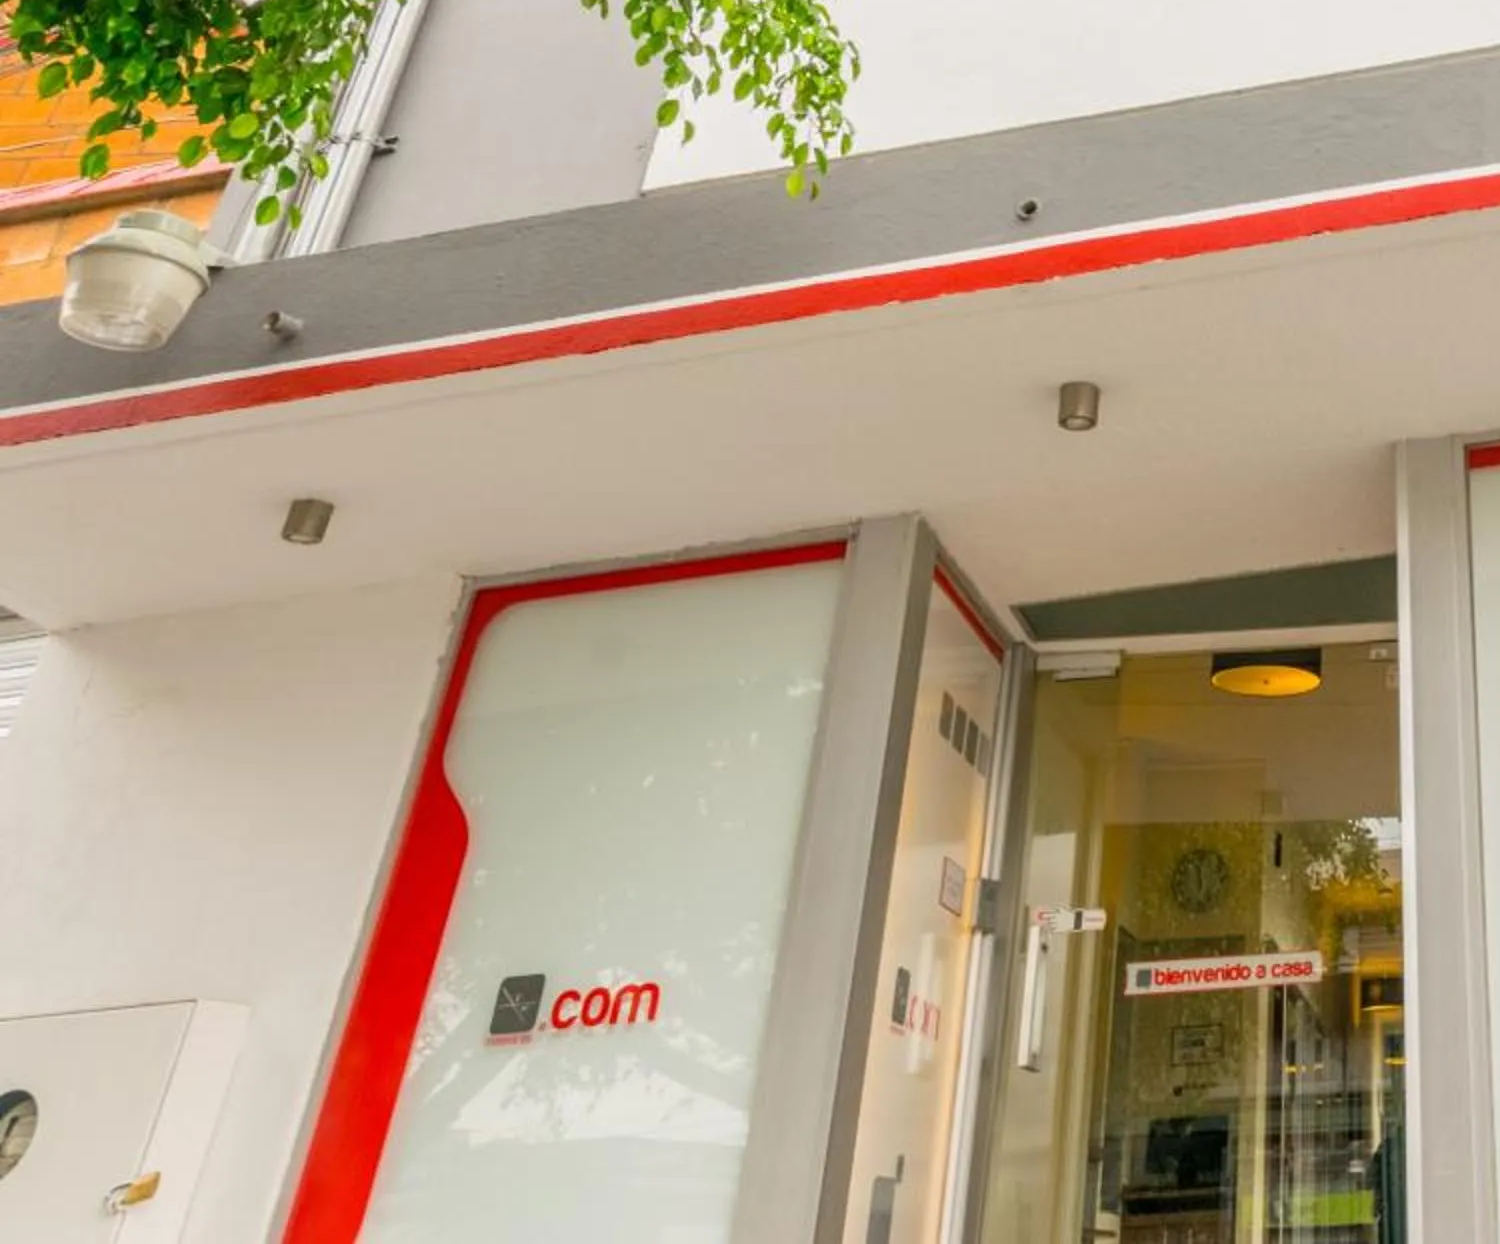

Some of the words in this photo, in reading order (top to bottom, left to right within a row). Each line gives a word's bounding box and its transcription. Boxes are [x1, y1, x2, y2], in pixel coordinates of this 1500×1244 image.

[1153, 964, 1250, 986] bienvenido
[1255, 964, 1265, 978] a
[1271, 961, 1313, 976] casa
[537, 981, 660, 1032] .com
